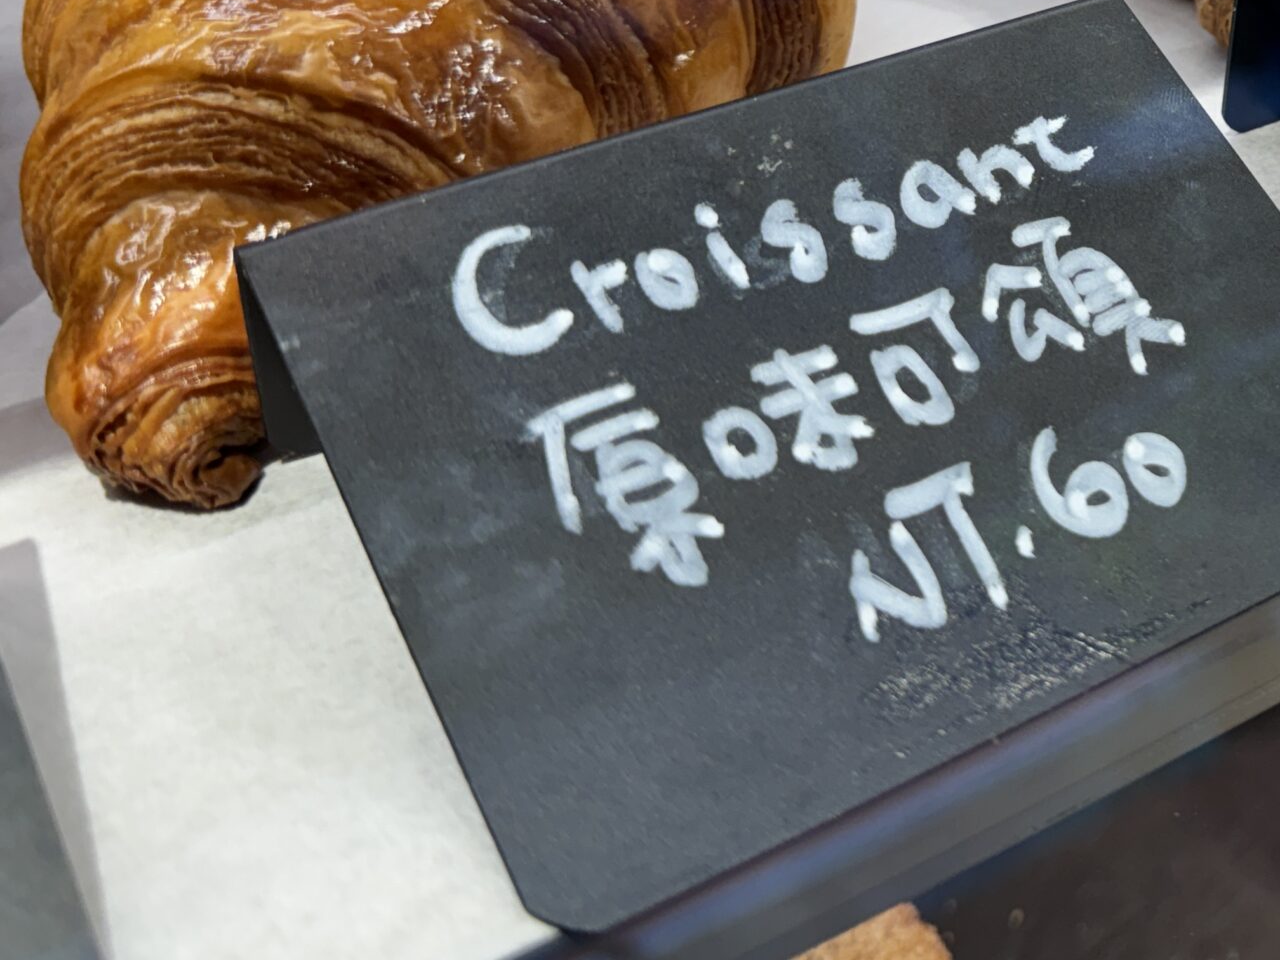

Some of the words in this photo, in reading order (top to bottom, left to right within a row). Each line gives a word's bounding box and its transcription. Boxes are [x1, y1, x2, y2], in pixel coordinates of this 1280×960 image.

[452, 115, 1096, 356] Croissant
[526, 216, 1187, 588] 原味可頌
[850, 426, 1188, 642] NT.60
